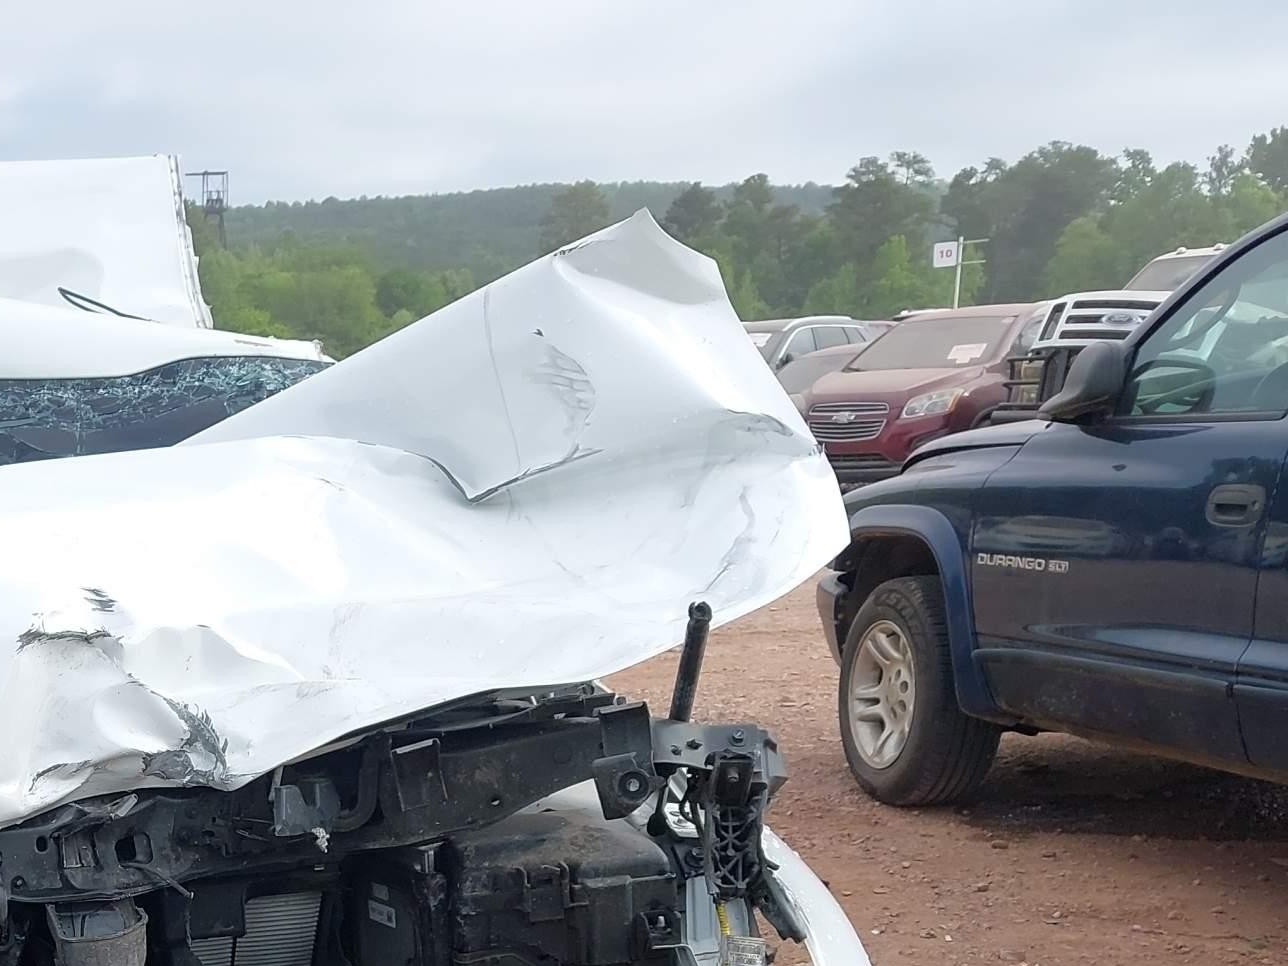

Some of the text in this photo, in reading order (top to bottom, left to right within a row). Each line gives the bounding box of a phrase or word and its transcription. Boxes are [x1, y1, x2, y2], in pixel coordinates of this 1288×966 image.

[939, 249, 952, 259] 10
[977, 553, 1069, 573] DURANGO SLT
